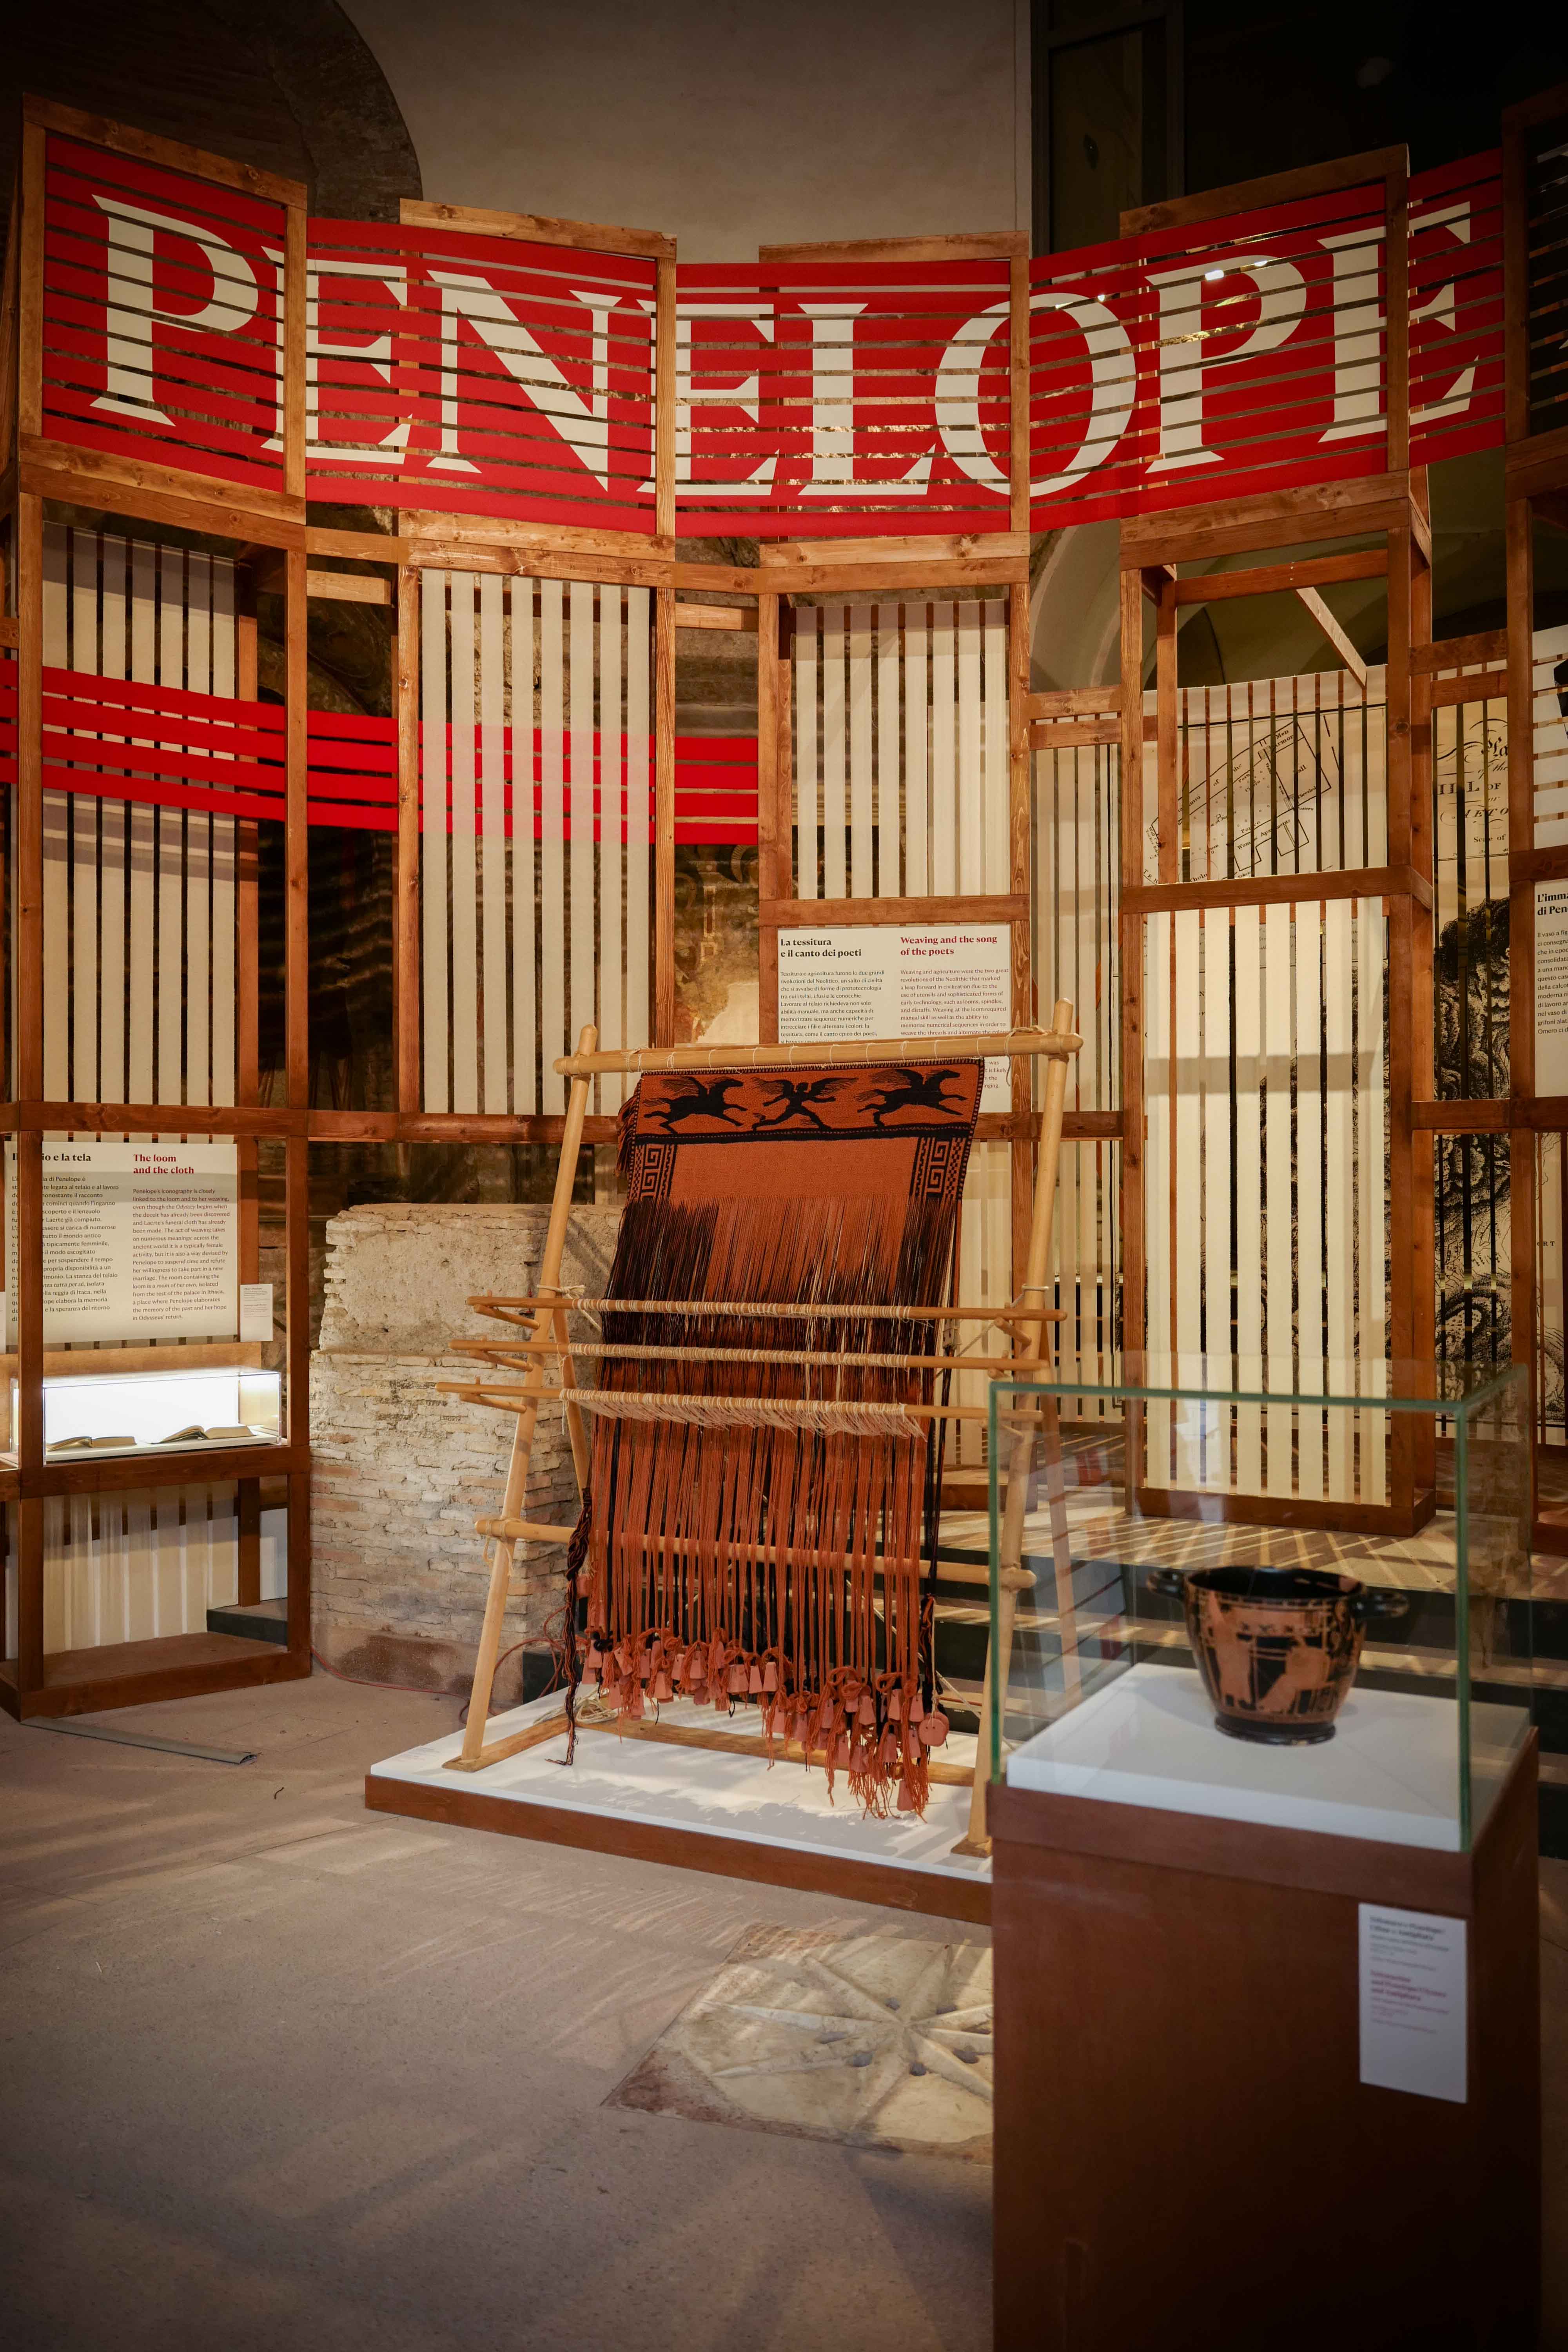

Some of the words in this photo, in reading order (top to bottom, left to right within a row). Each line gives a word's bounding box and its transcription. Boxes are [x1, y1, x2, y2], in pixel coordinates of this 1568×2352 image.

[92, 195, 1474, 496] PENELOPE
[900, 936, 938, 945] Weaving
[838, 949, 861, 958] poeti
[929, 948, 954, 956] poets
